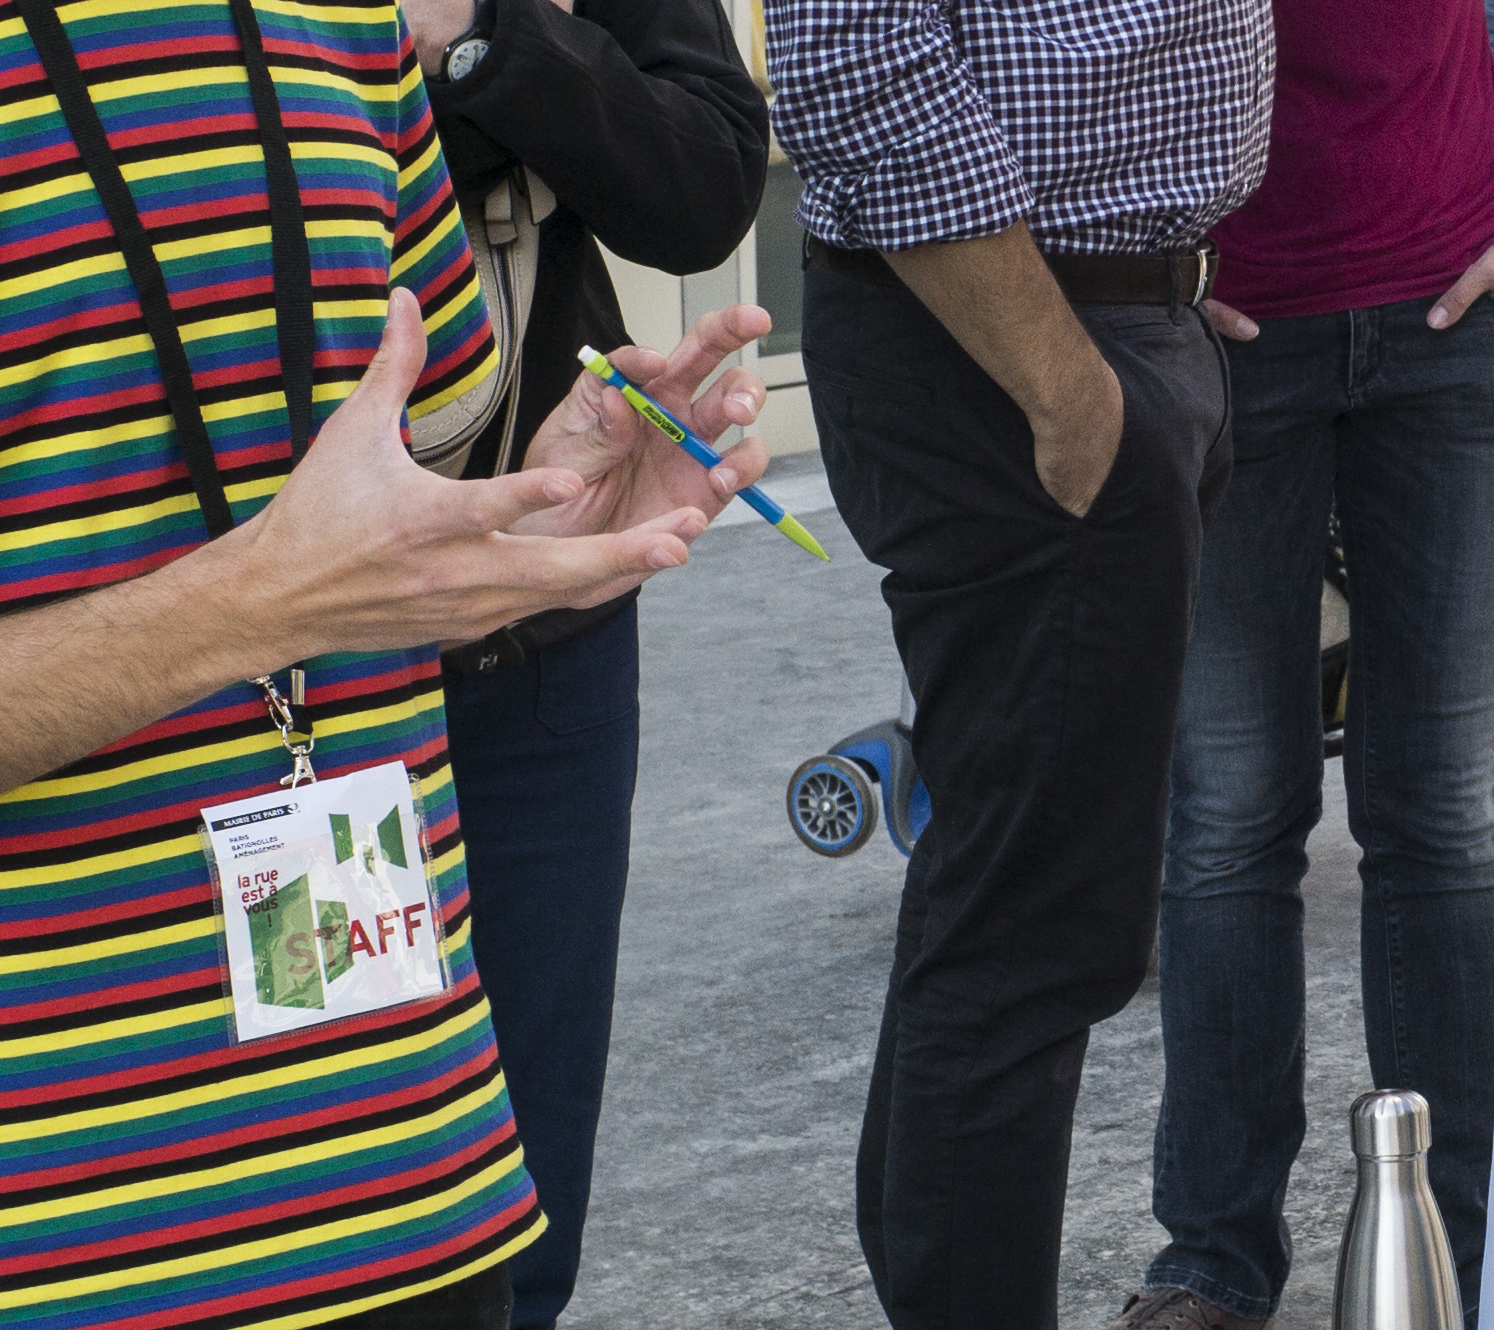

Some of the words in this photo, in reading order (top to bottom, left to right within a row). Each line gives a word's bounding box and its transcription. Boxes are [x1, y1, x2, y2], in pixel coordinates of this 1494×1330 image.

[224, 816, 250, 827] MAIRIE
[251, 813, 261, 821] DE
[263, 809, 285, 819] PARIS
[229, 834, 249, 843] PARIS
[231, 836, 278, 851] BATIGNOLLES
[238, 875, 250, 888] la
[255, 869, 278, 885] rue
[242, 886, 264, 903] est
[269, 880, 277, 897] à
[243, 898, 278, 915] vous
[268, 913, 272, 928] !
[285, 902, 426, 975] STAFF
